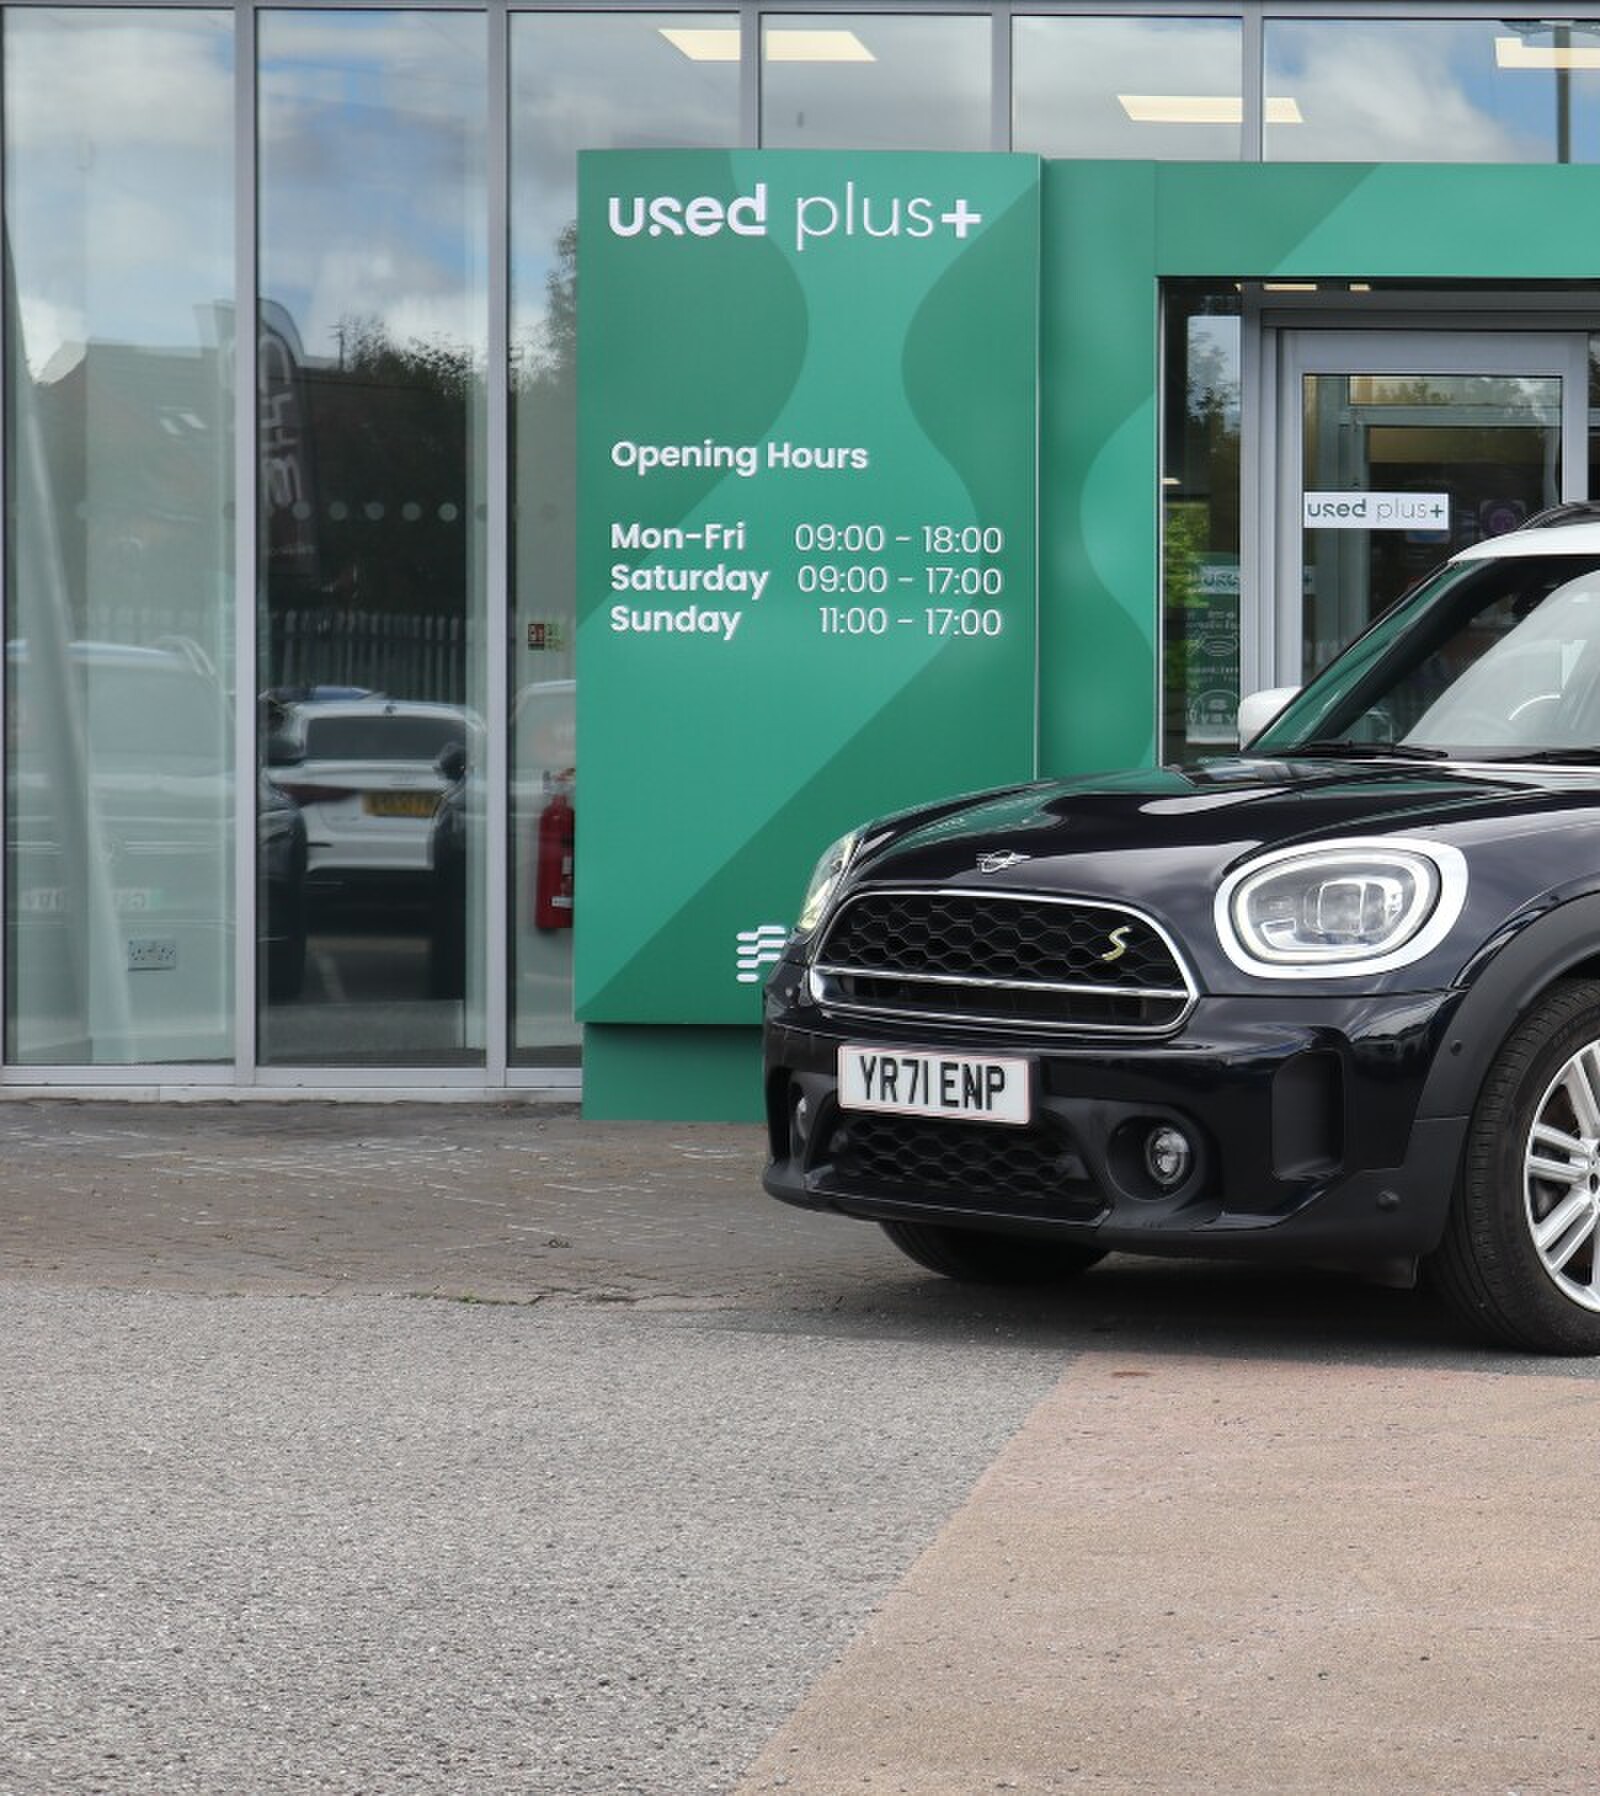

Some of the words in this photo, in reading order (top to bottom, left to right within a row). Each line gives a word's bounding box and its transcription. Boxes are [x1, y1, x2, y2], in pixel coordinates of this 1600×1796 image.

[609, 182, 768, 237] used
[796, 181, 982, 252] plus+
[611, 439, 758, 477] Opening
[767, 441, 869, 470] Hours
[1307, 498, 1367, 518] used
[1376, 499, 1445, 522] plus+
[610, 521, 745, 551] Mon-Fri
[795, 523, 885, 553] 09:00
[922, 525, 1003, 555] 18:00
[610, 563, 770, 601] Saturday
[798, 565, 888, 594] 09:00
[925, 567, 1002, 596] 17:00
[610, 605, 742, 641] Sunday
[819, 607, 888, 636] 11:00
[925, 608, 1002, 637] 17:00
[1101, 926, 1131, 961] S
[859, 1055, 929, 1105] YR71
[939, 1061, 1006, 1112] ENP
